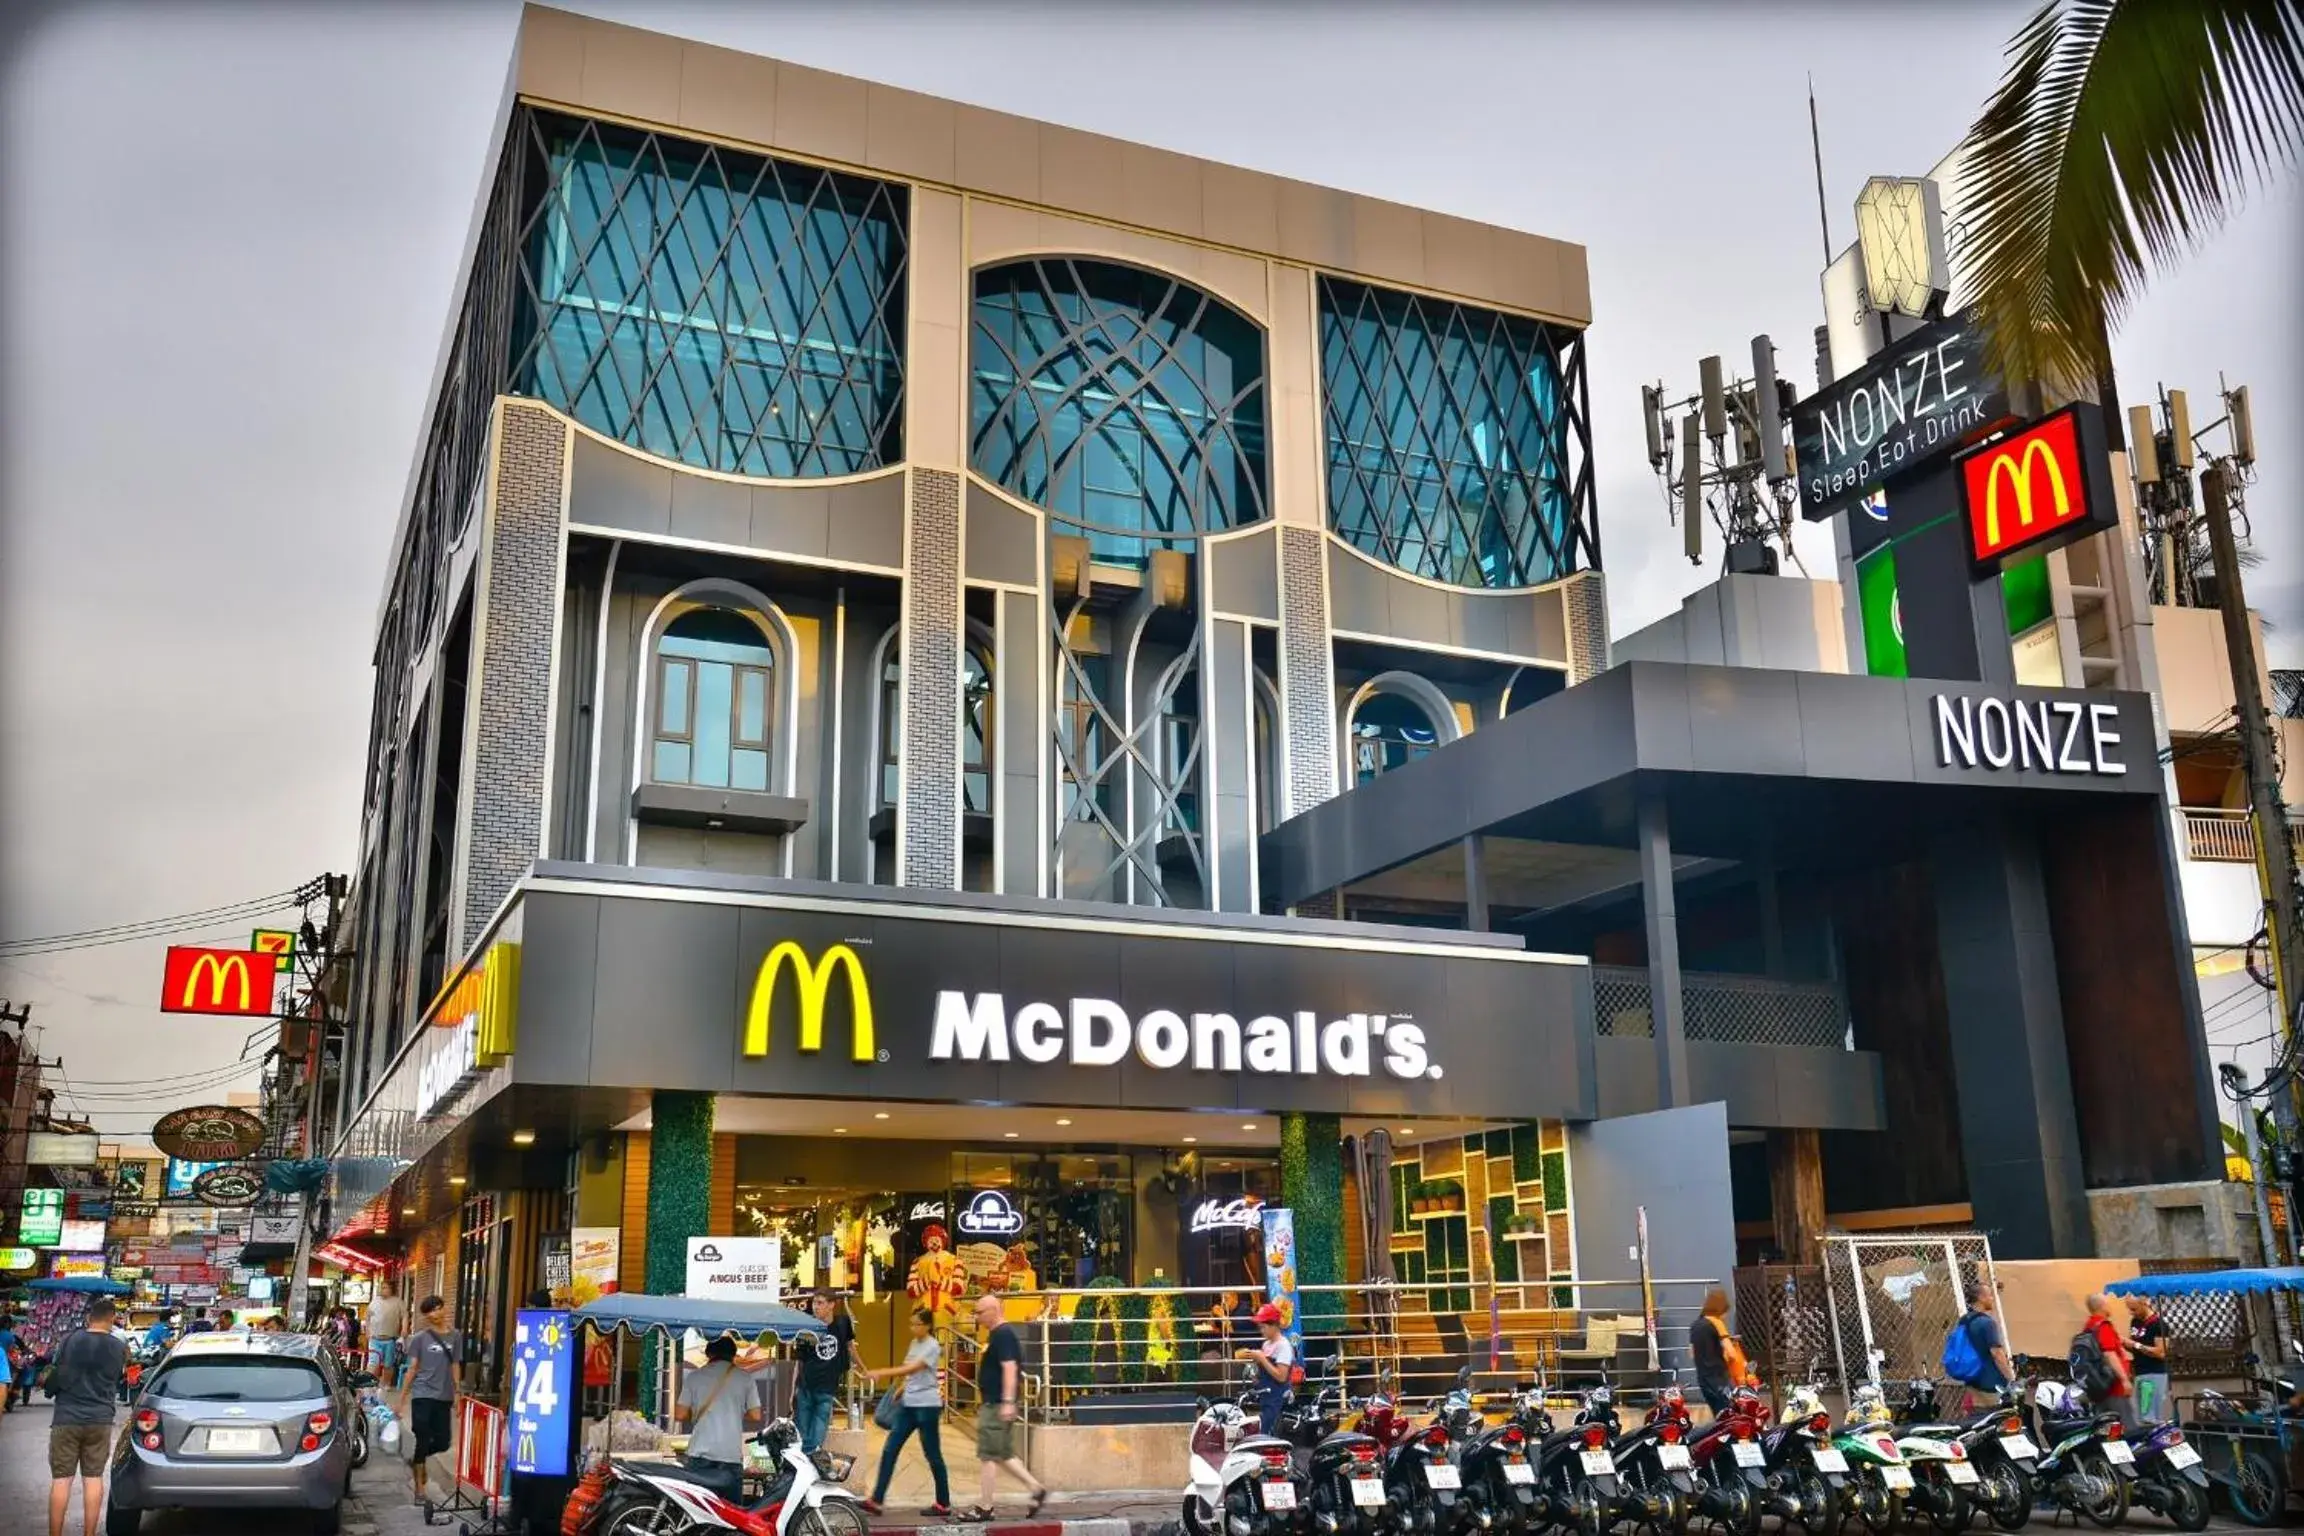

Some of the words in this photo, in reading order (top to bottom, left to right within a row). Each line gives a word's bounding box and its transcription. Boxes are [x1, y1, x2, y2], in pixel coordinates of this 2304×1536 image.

[1818, 333, 1968, 465] NONZE
[1934, 694, 2127, 774] NONZE
[709, 1274, 742, 1284] ANGUS
[744, 1274, 769, 1284] BEEF
[513, 1357, 559, 1415] 24
